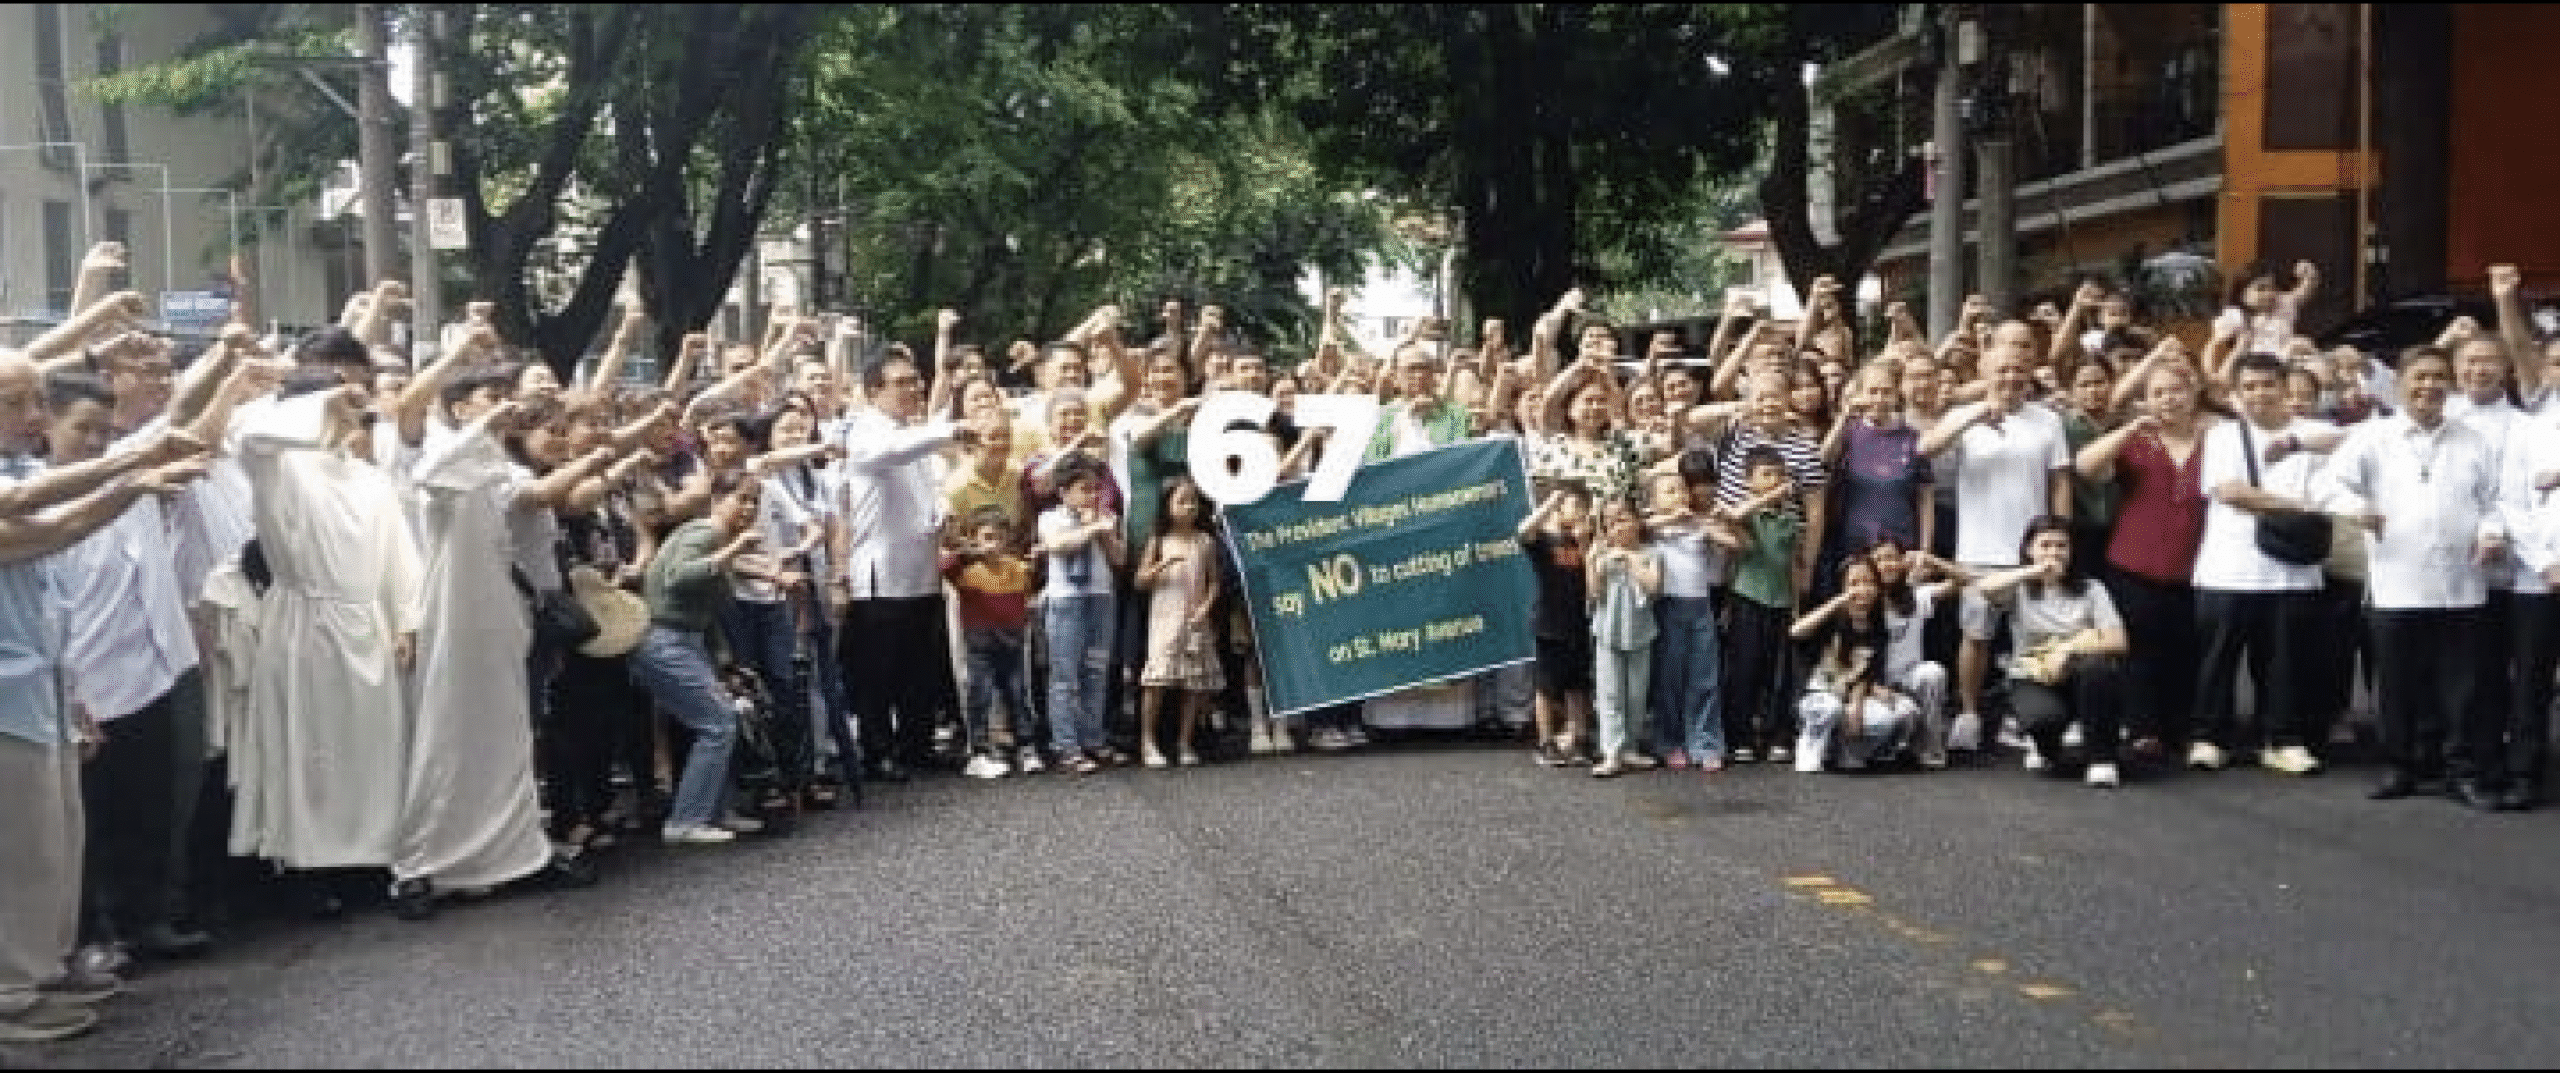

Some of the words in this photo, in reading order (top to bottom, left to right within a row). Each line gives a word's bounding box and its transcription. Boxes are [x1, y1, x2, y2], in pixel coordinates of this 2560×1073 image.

[1246, 531, 1274, 551] The
[1272, 592, 1303, 617] say
[1307, 553, 1362, 605] NO
[1369, 566, 1391, 584] to
[1393, 552, 1451, 579] cutting
[1454, 543, 1470, 566] of
[1329, 643, 1352, 664] on
[1379, 628, 1420, 652] Mary
